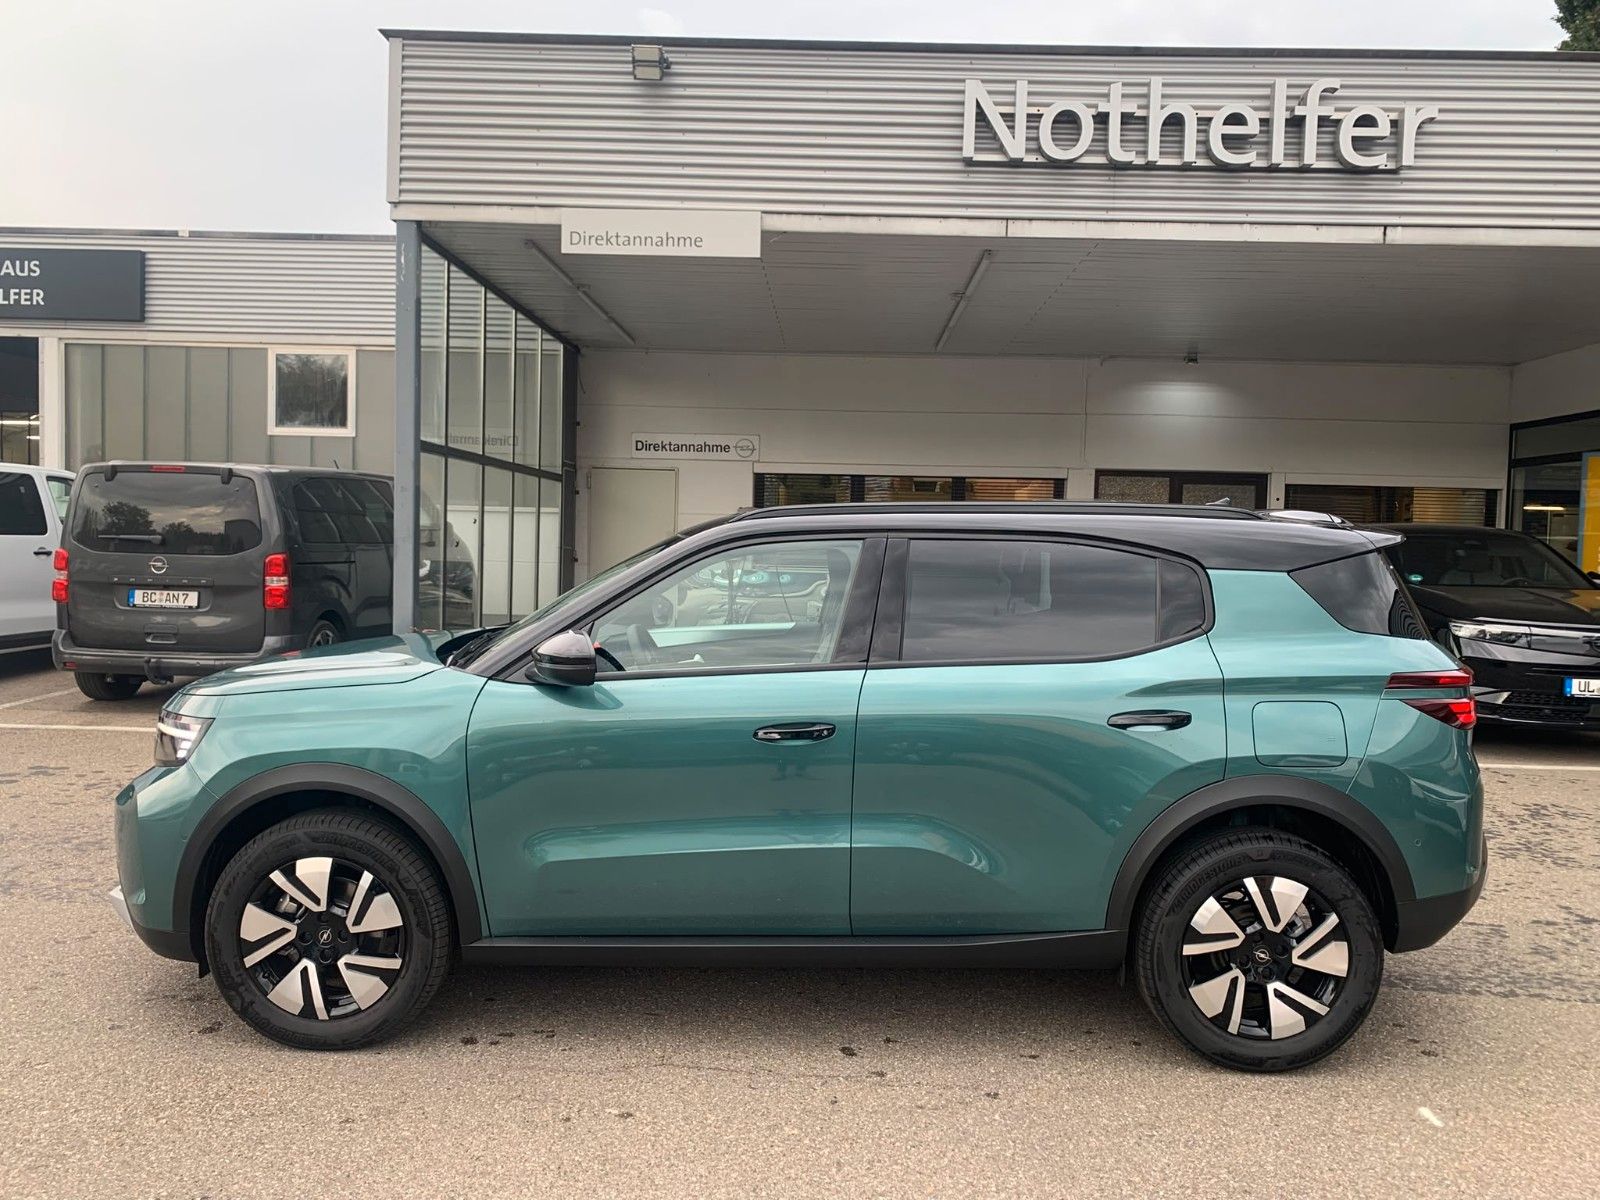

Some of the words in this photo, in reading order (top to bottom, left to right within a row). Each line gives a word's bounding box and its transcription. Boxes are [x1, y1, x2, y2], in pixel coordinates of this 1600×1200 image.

[962, 77, 1439, 169] Nothelfer
[569, 230, 704, 248] Direktannahme
[0, 260, 41, 277] AUS
[635, 439, 731, 454] Direktannahme
[142, 591, 157, 603] BC
[164, 592, 180, 604] AN
[182, 593, 189, 605] 7
[1578, 680, 1595, 693] UL
